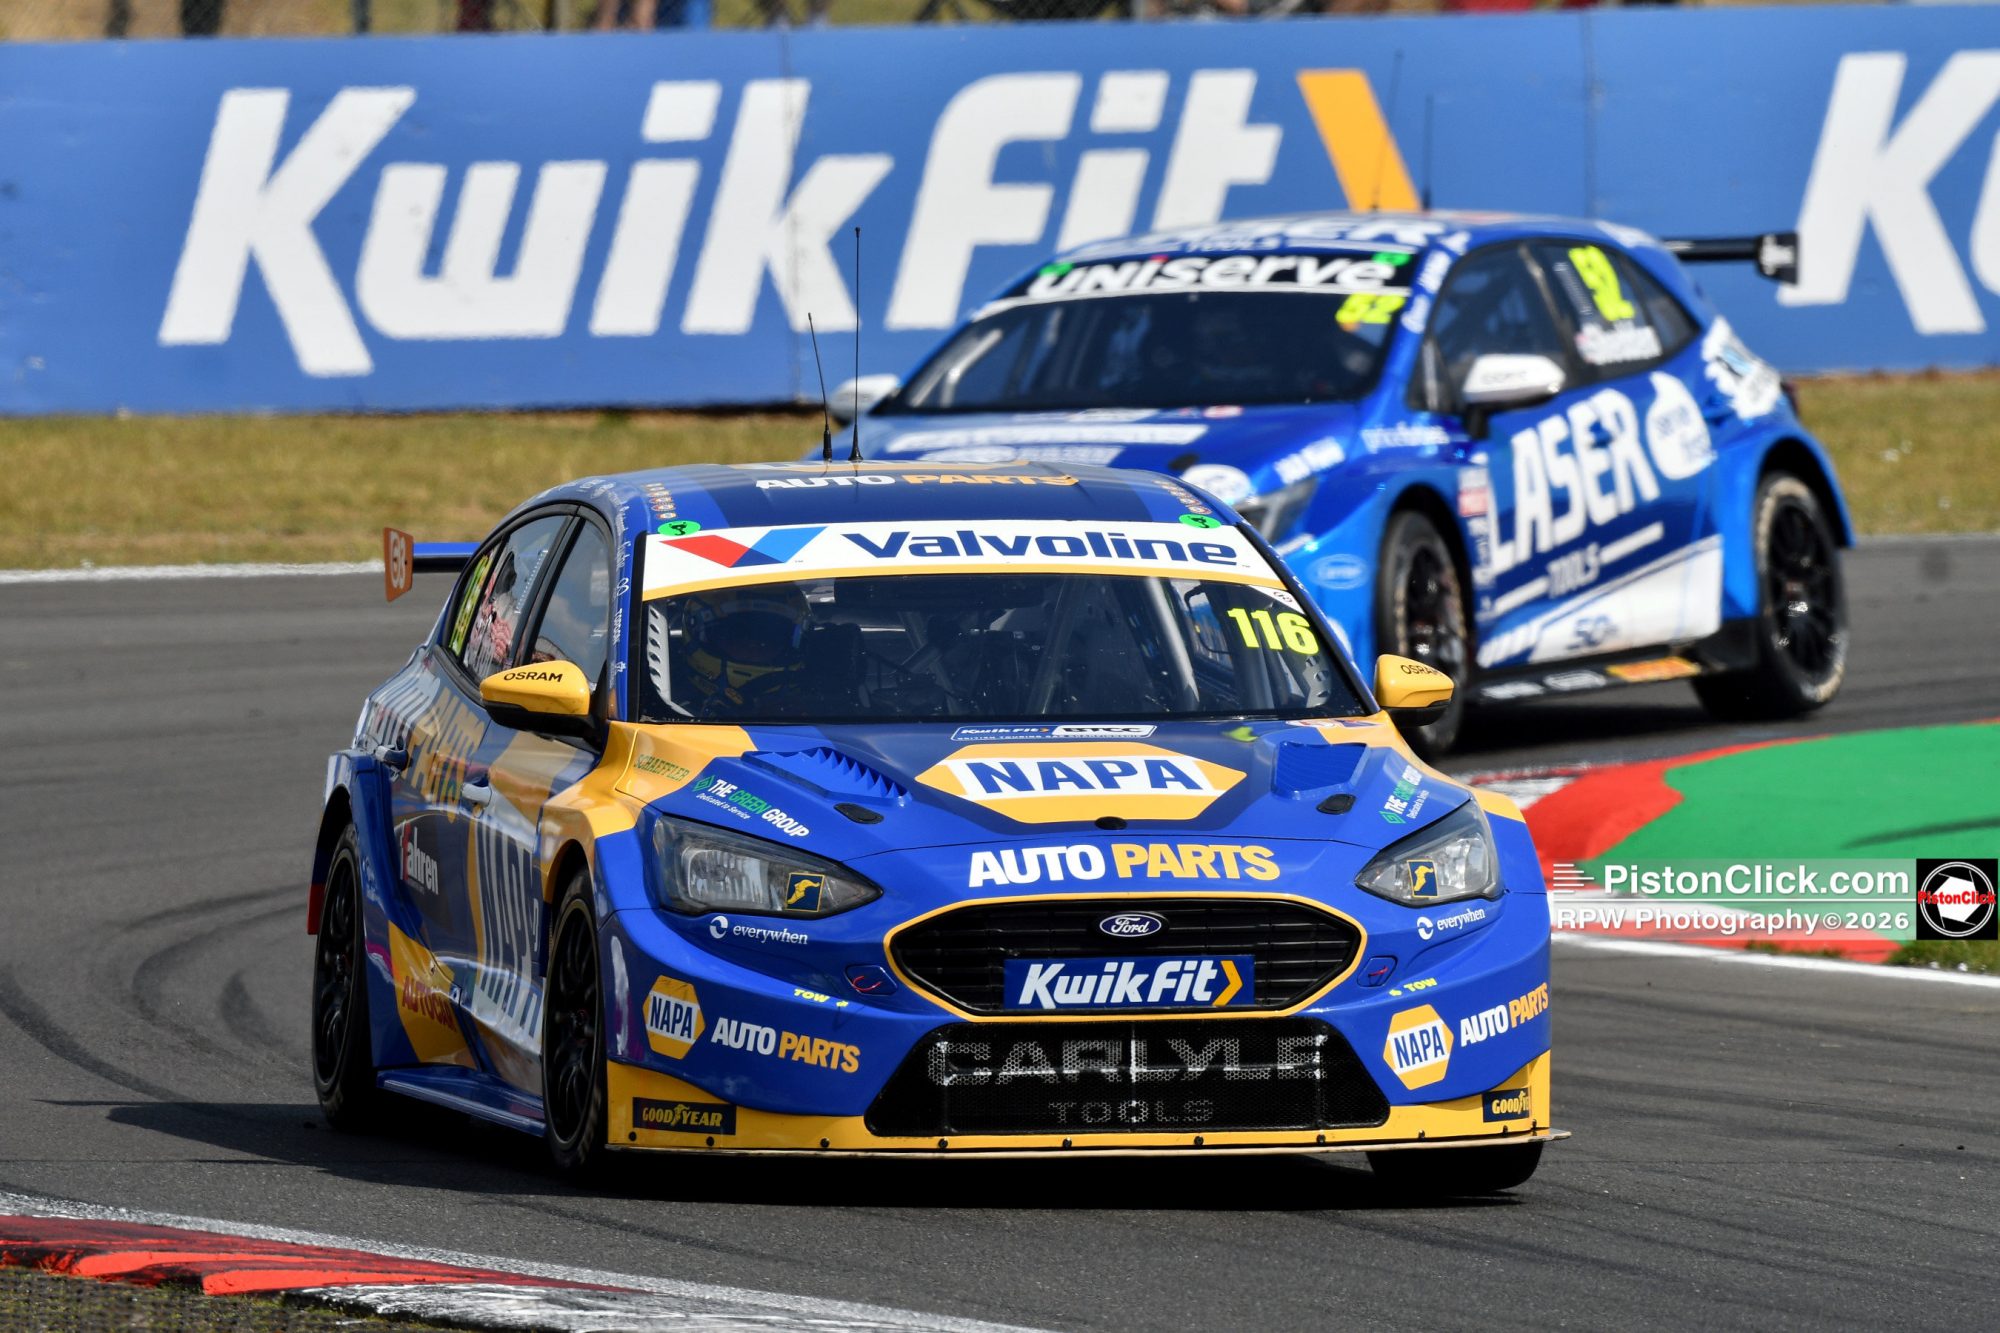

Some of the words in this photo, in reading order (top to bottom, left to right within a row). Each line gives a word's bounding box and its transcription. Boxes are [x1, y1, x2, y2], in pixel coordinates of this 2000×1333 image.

[1776, 49, 2000, 336] K
[756, 475, 896, 489] AUTO
[1485, 388, 1661, 577] LASER
[840, 530, 1238, 566] Valvoline
[1227, 608, 1319, 655] 116
[503, 671, 563, 683] OSRAM
[966, 758, 1205, 794] NAPA
[708, 779, 738, 798] THE
[728, 789, 771, 815] GREEN
[762, 808, 810, 838] GROUP
[968, 844, 1105, 887] AUTO
[1111, 843, 1281, 881] PARTS
[733, 924, 808, 945] everywhen
[1110, 916, 1150, 934] Ford
[1437, 908, 1486, 932] everywhen
[794, 988, 829, 1003] TOW
[1403, 977, 1437, 992] TOW
[650, 995, 693, 1039] NAPA
[1460, 1004, 1509, 1047] AUTO
[1509, 982, 1549, 1028] PARTS
[710, 1017, 776, 1056] AUTO
[777, 1031, 861, 1073] PARTS
[928, 1036, 1328, 1086] CARLYLE
[1394, 1025, 1445, 1069] NAPA
[642, 1104, 723, 1128] GOODYEAR
